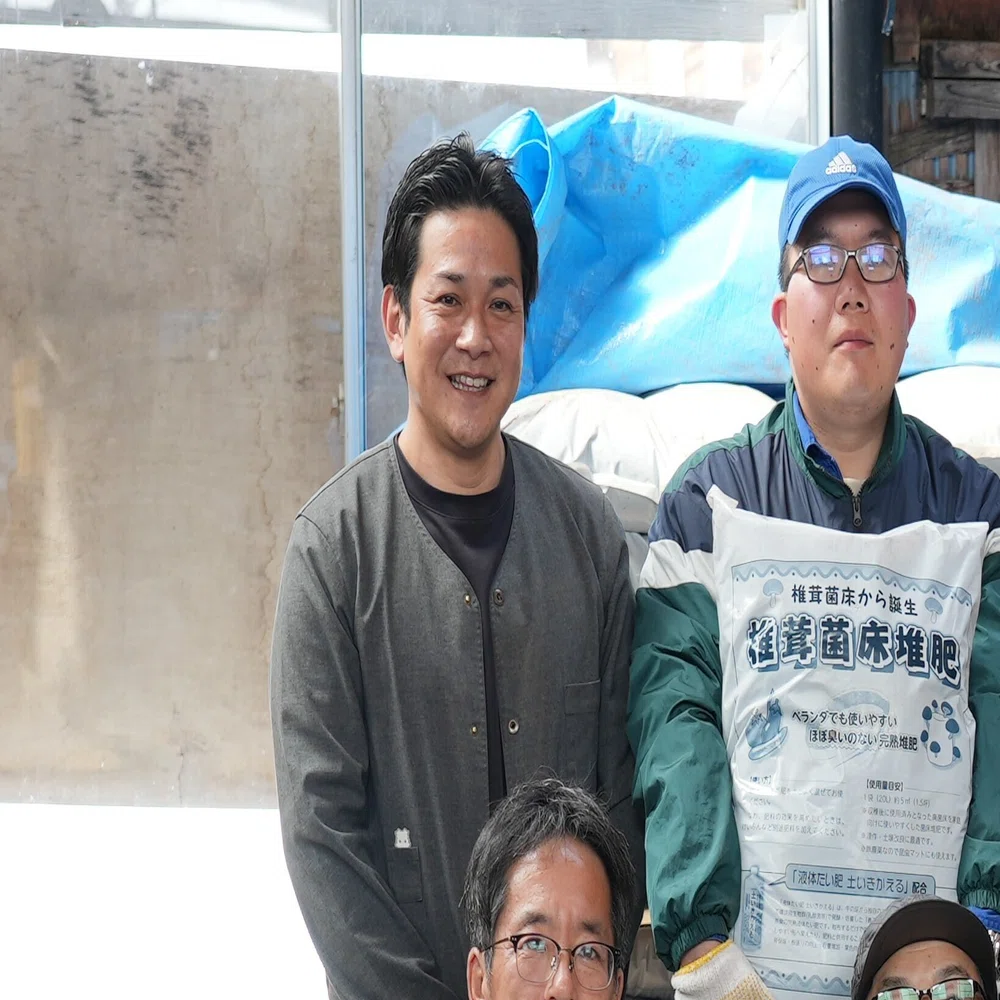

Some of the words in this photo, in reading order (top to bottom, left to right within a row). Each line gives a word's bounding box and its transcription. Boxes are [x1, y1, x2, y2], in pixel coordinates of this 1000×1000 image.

[826, 164, 856, 175] adidas
[791, 584, 918, 616] 椎茸菌床から誕生
[748, 613, 961, 689] 椎茸菌床堆肥
[792, 710, 897, 728] ベランダでも使いやすい
